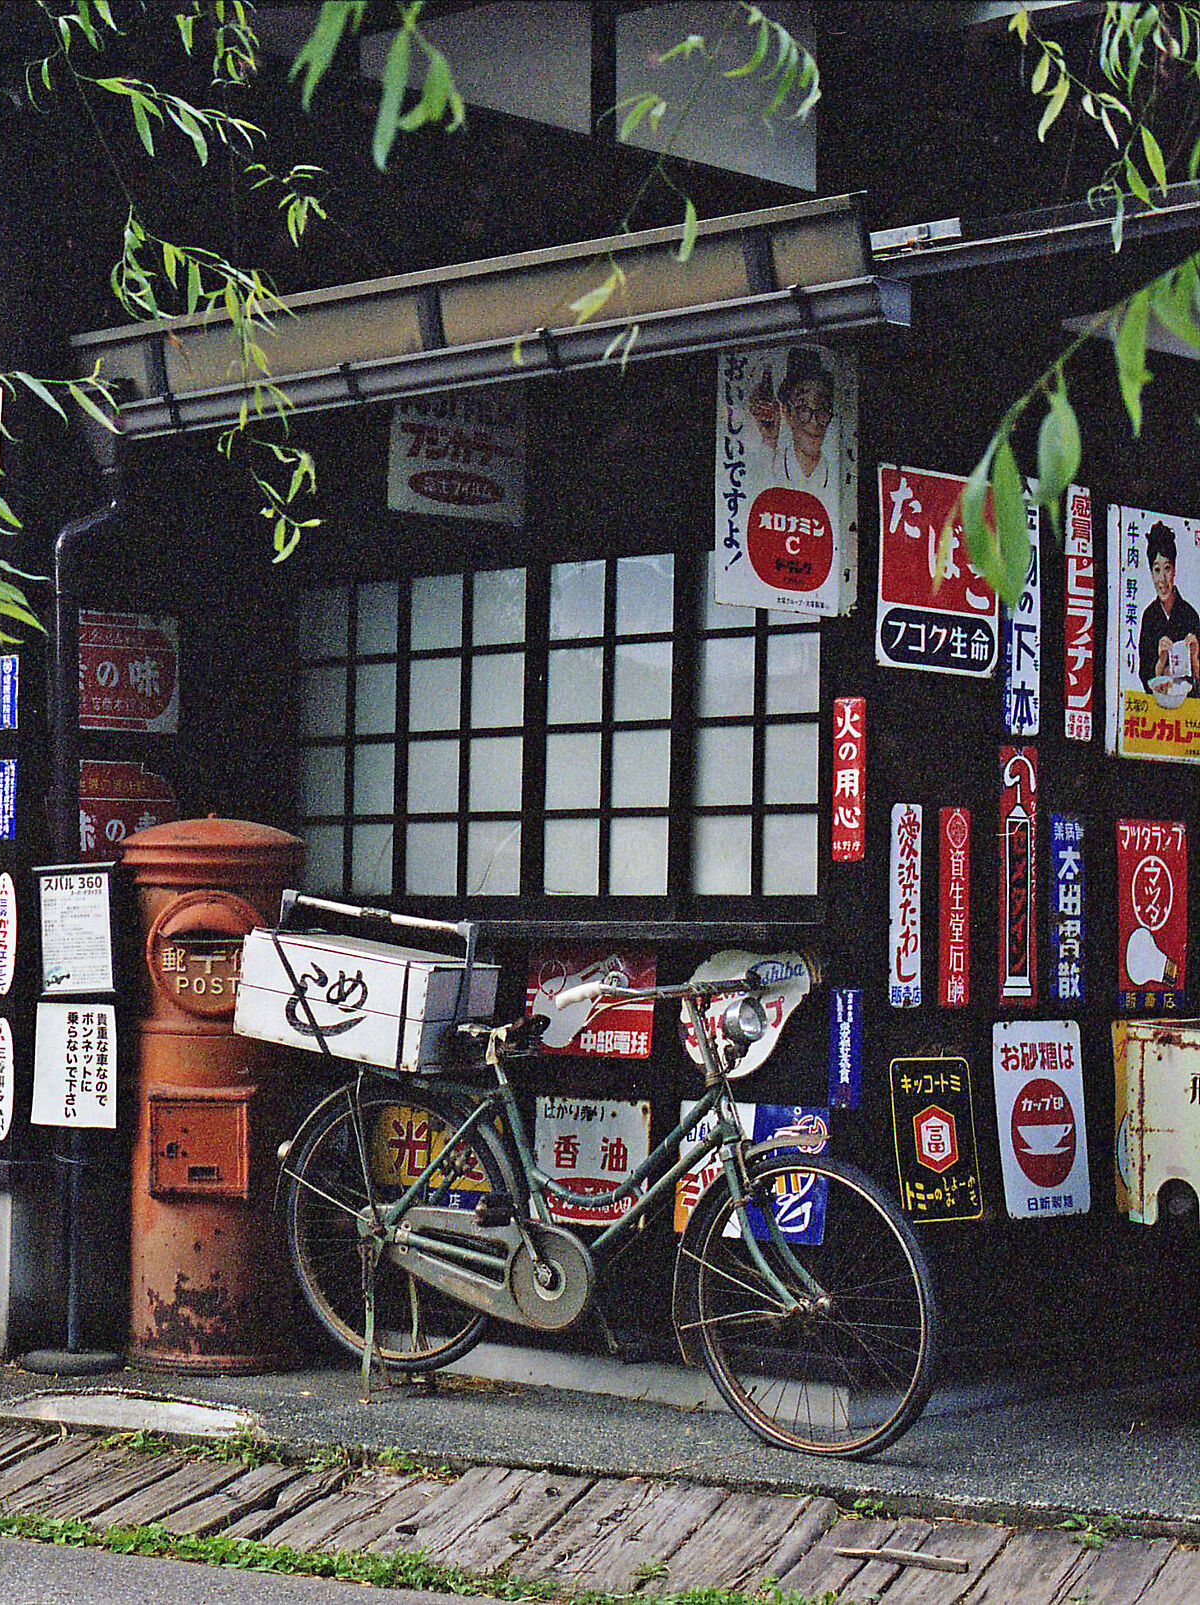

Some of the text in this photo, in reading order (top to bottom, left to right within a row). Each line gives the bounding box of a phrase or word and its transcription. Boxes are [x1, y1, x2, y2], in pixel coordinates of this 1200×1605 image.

[758, 512, 825, 537] オロナミン
[785, 536, 801, 555] C
[1125, 521, 1140, 674] 牛肉 野菜入り
[888, 620, 990, 662] フコク生命
[1124, 715, 1200, 743] ボンカレー
[834, 706, 861, 829] 火の用心
[43, 876, 103, 892] スバル 360
[176, 976, 240, 995] POST
[81, 1012, 94, 1093] ボンネットに
[580, 1030, 649, 1054] 中部電球
[64, 1011, 79, 1119] 乗らないで下さい
[96, 1013, 109, 1107] 貴重な車なので
[1000, 1042, 1075, 1071] お砂糖は
[900, 1073, 961, 1094] キッコートミ
[1021, 1094, 1065, 1112] カップ印
[554, 1134, 629, 1172] 香油
